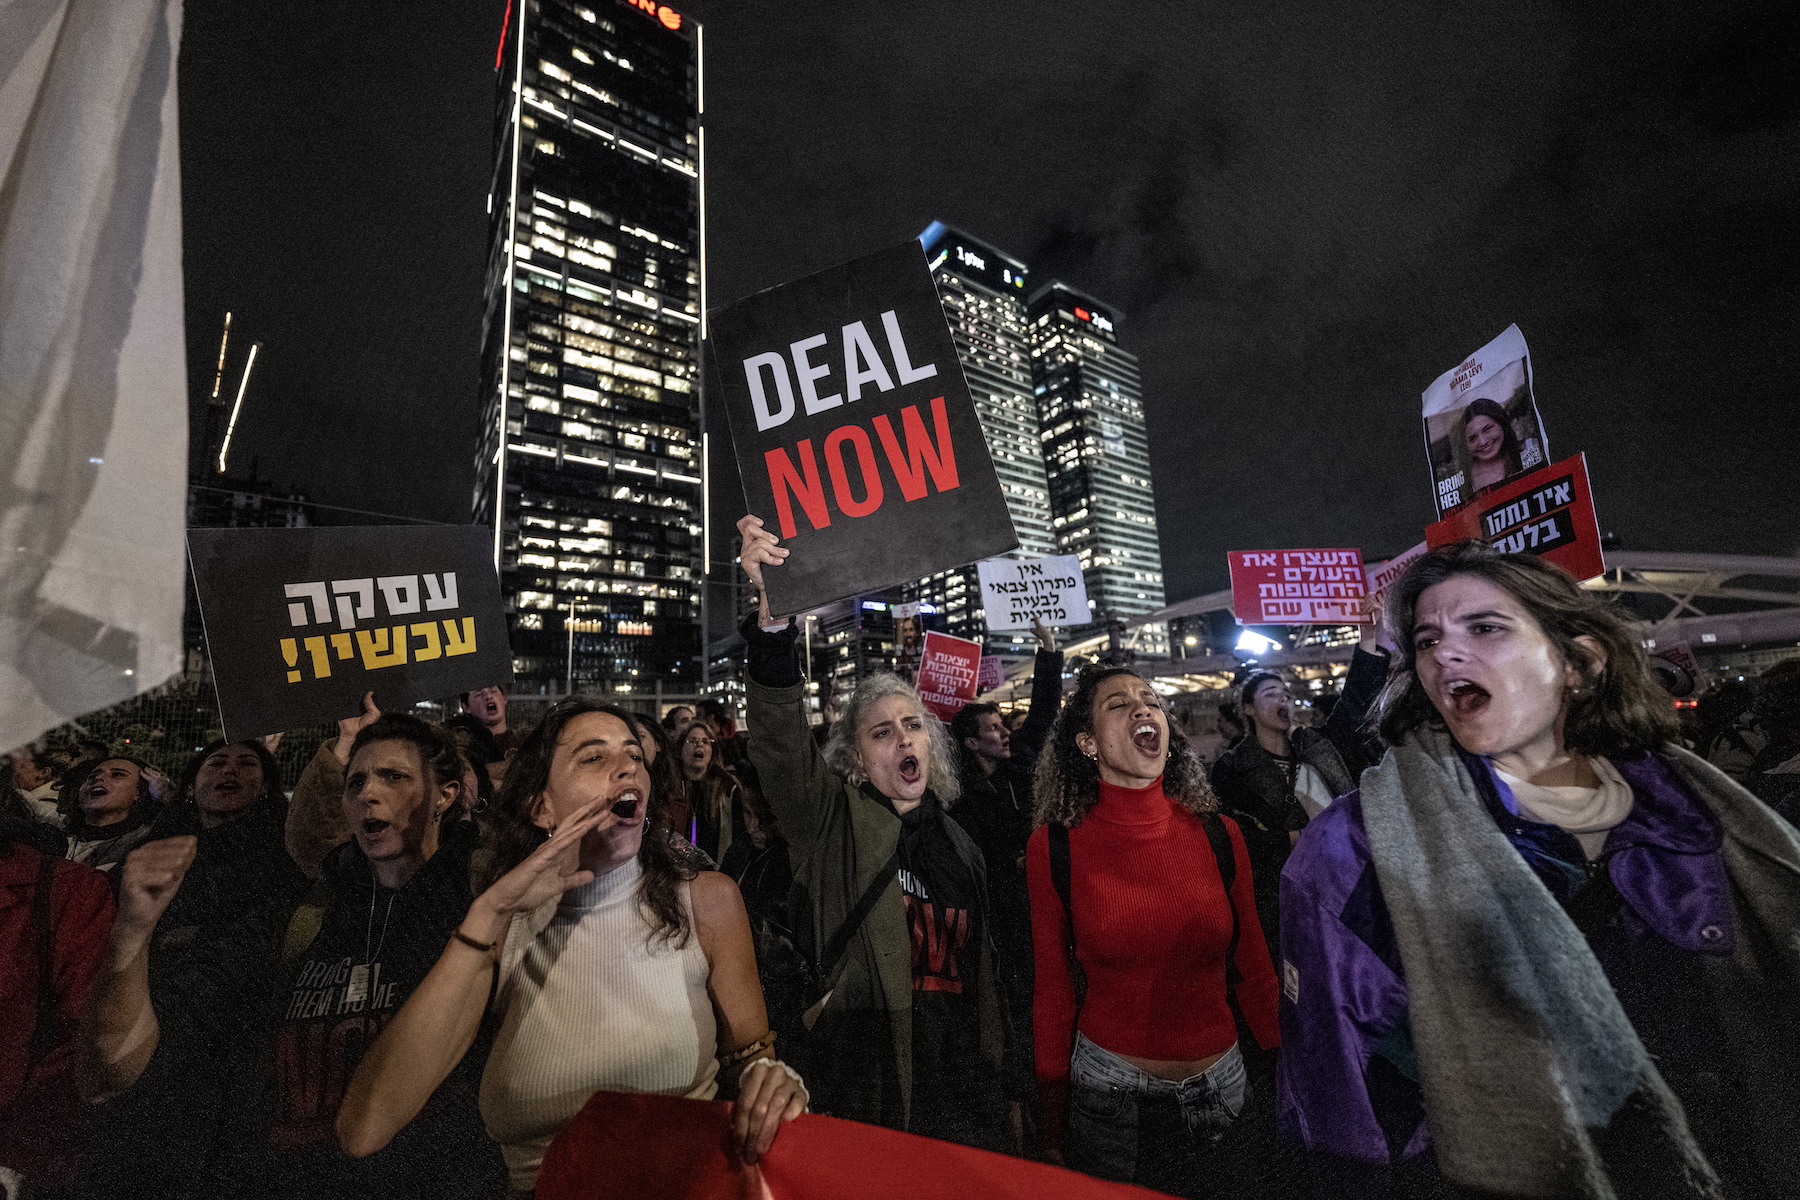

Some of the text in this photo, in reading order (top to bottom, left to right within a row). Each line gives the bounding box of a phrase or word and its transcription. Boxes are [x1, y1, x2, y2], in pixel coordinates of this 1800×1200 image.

[743, 309, 938, 432] DEAL
[764, 395, 960, 540] NOW
[1437, 470, 1465, 496] BRING
[1439, 489, 1461, 511] HER
[1492, 517, 1561, 554] בלעד
[1242, 551, 1358, 567] תעצרו את
[1016, 563, 1043, 580] אין
[1283, 565, 1362, 582] העולם
[989, 576, 1077, 594] פתרון צבאי
[1258, 583, 1365, 598] החטופות
[284, 572, 459, 630] עסקה
[1010, 591, 1060, 609] לבעיה
[1263, 601, 1303, 616] שם
[280, 616, 477, 683] עכשיו!
[934, 651, 971, 667] יוצאות
[925, 660, 975, 679] לרחובות
[928, 670, 971, 688] להחזיר
[937, 683, 957, 696] את
[296, 956, 352, 989] BRING
[285, 986, 336, 1019] THEM
[276, 1013, 393, 1121] NO
